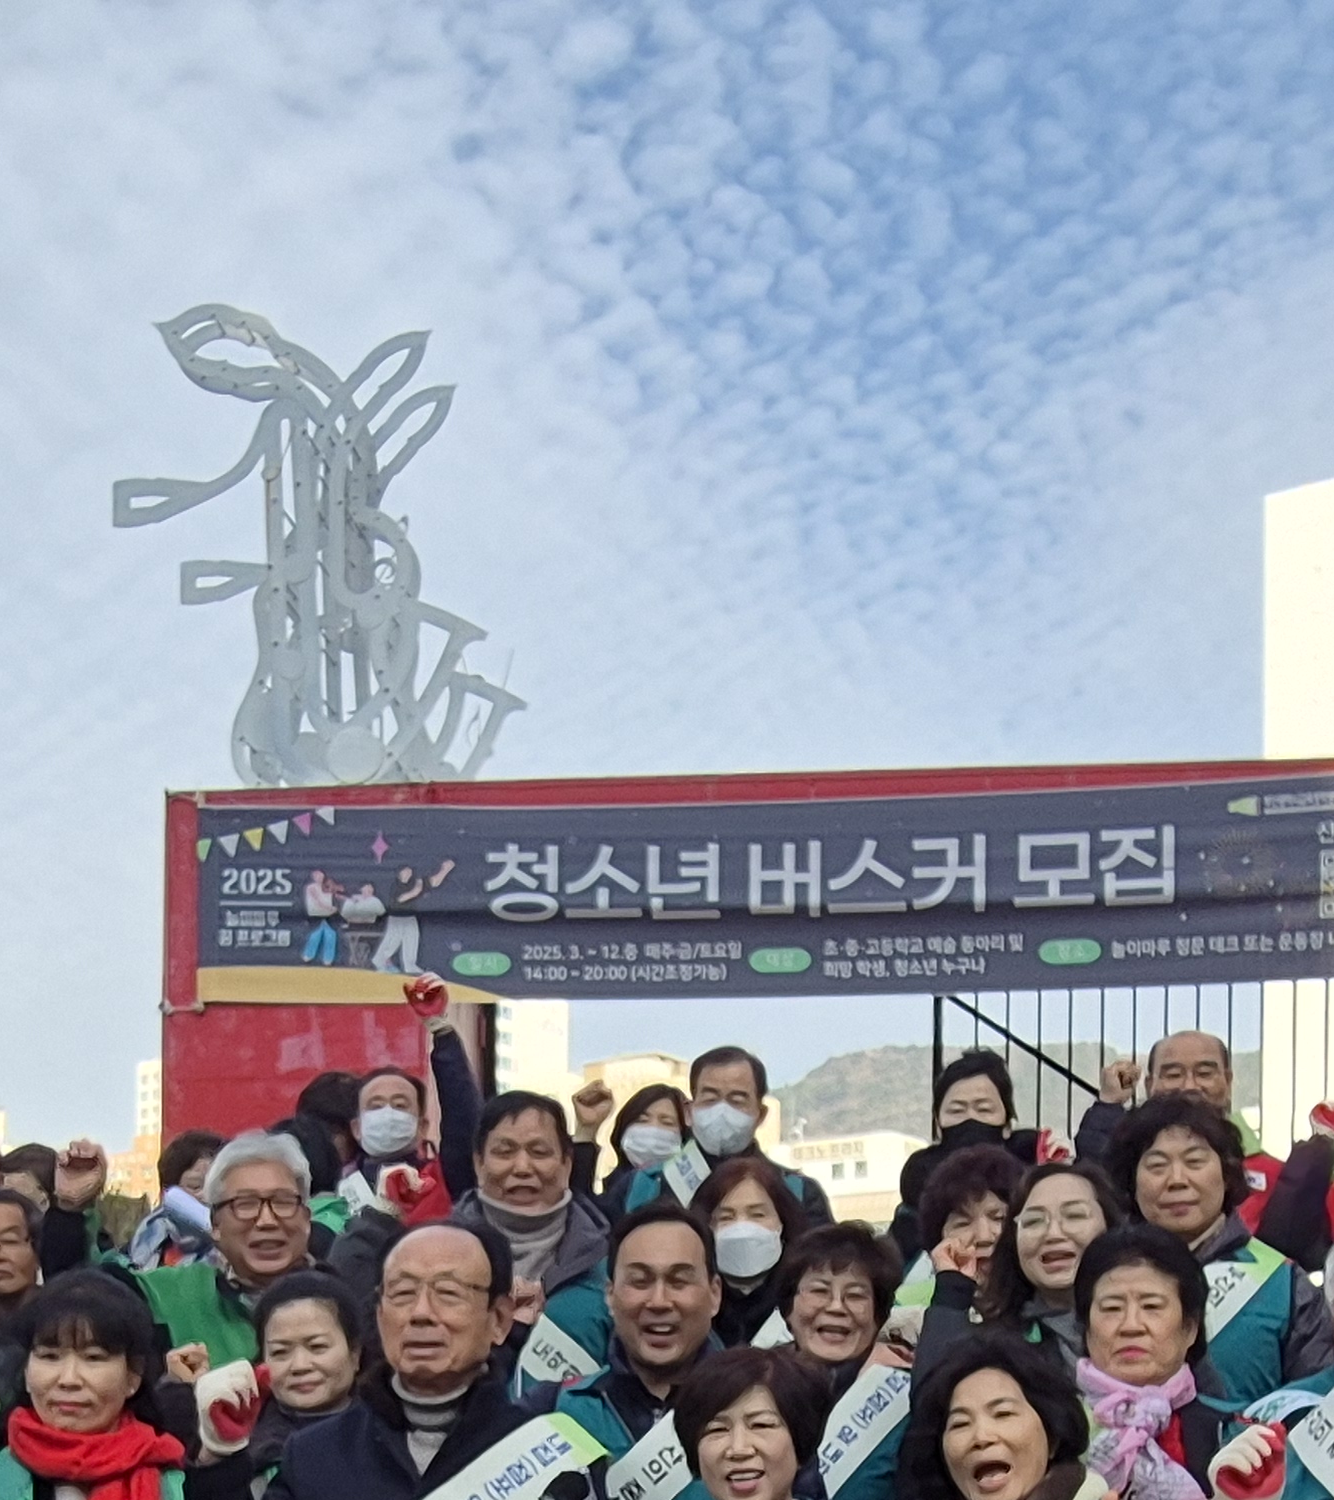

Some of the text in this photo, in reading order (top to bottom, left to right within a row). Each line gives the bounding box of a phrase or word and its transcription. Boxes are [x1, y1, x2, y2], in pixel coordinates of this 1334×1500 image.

[221, 868, 293, 895] 2025
[485, 824, 1175, 922] 청소년 버스커 모집
[524, 966, 568, 981] 14:00
[583, 965, 628, 981] 20:00
